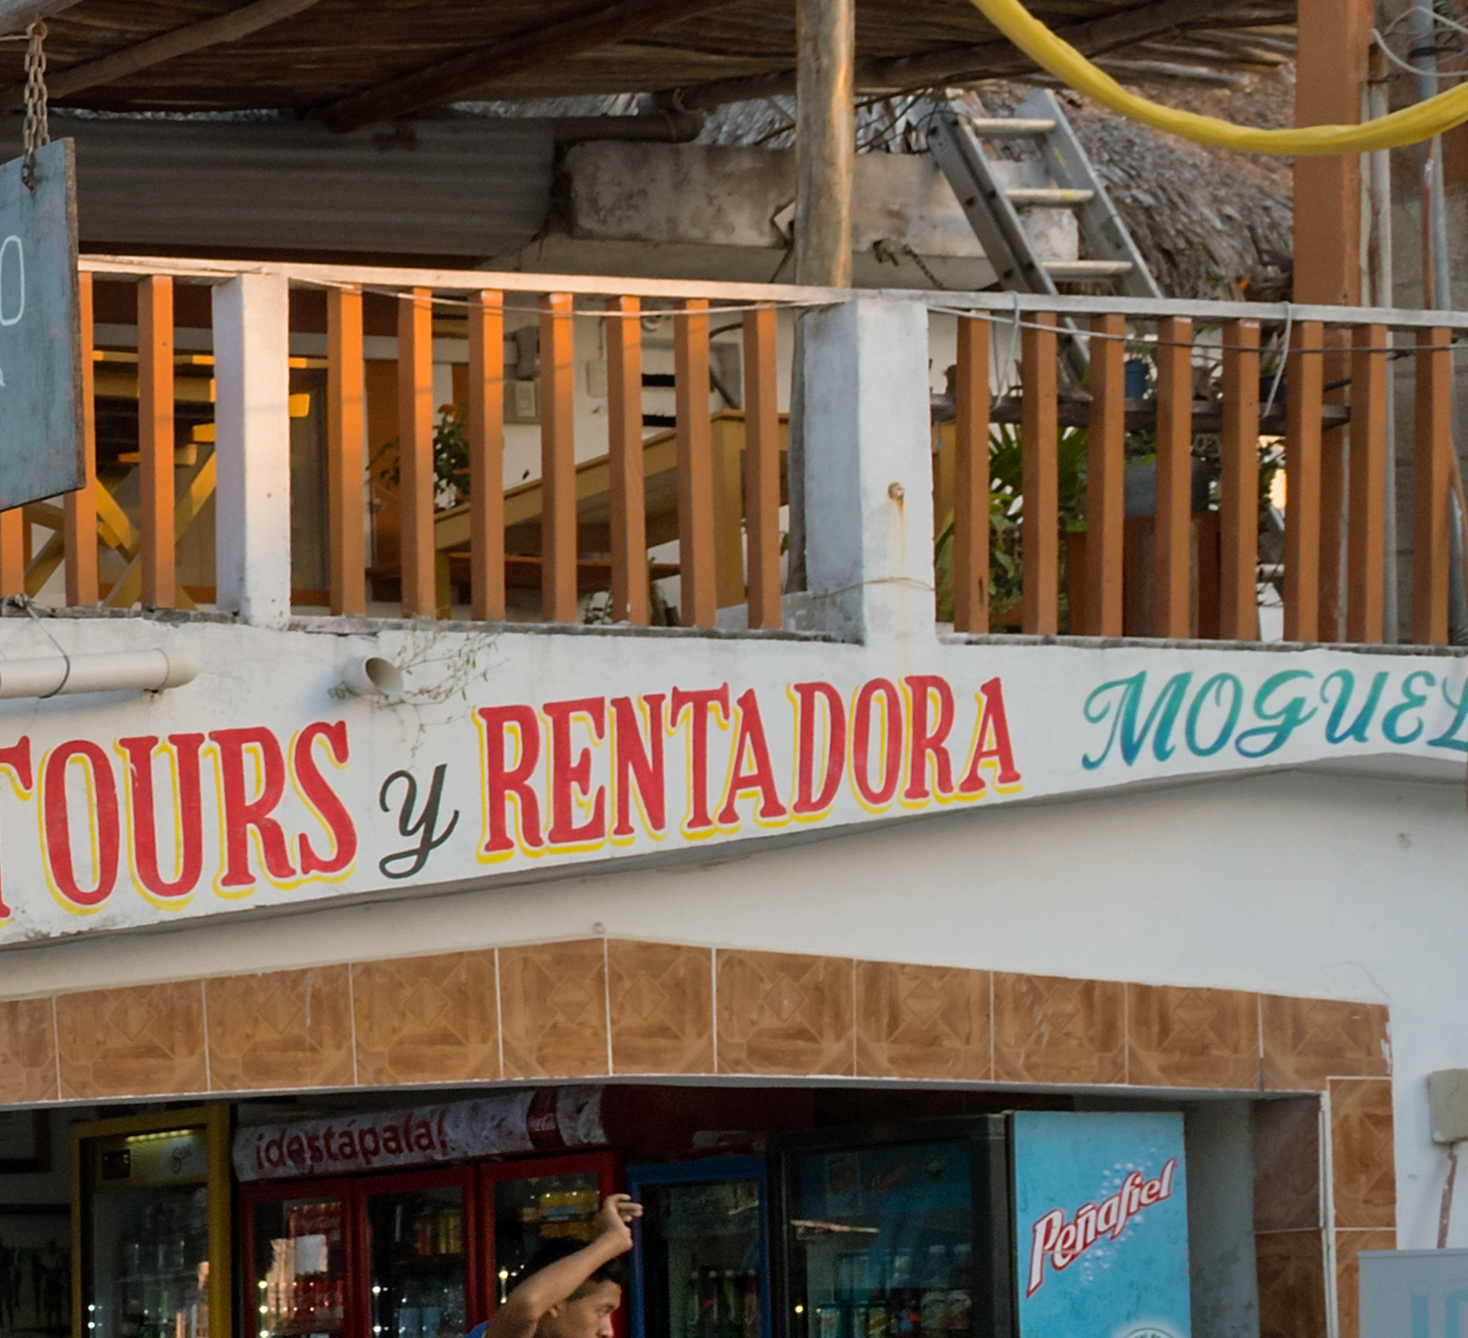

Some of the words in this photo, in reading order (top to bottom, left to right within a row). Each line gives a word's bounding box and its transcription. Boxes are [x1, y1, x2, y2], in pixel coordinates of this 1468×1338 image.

[379, 764, 458, 880] y
[476, 676, 1023, 861] RENTADORA
[1026, 1157, 1177, 1299] Peñafiel
